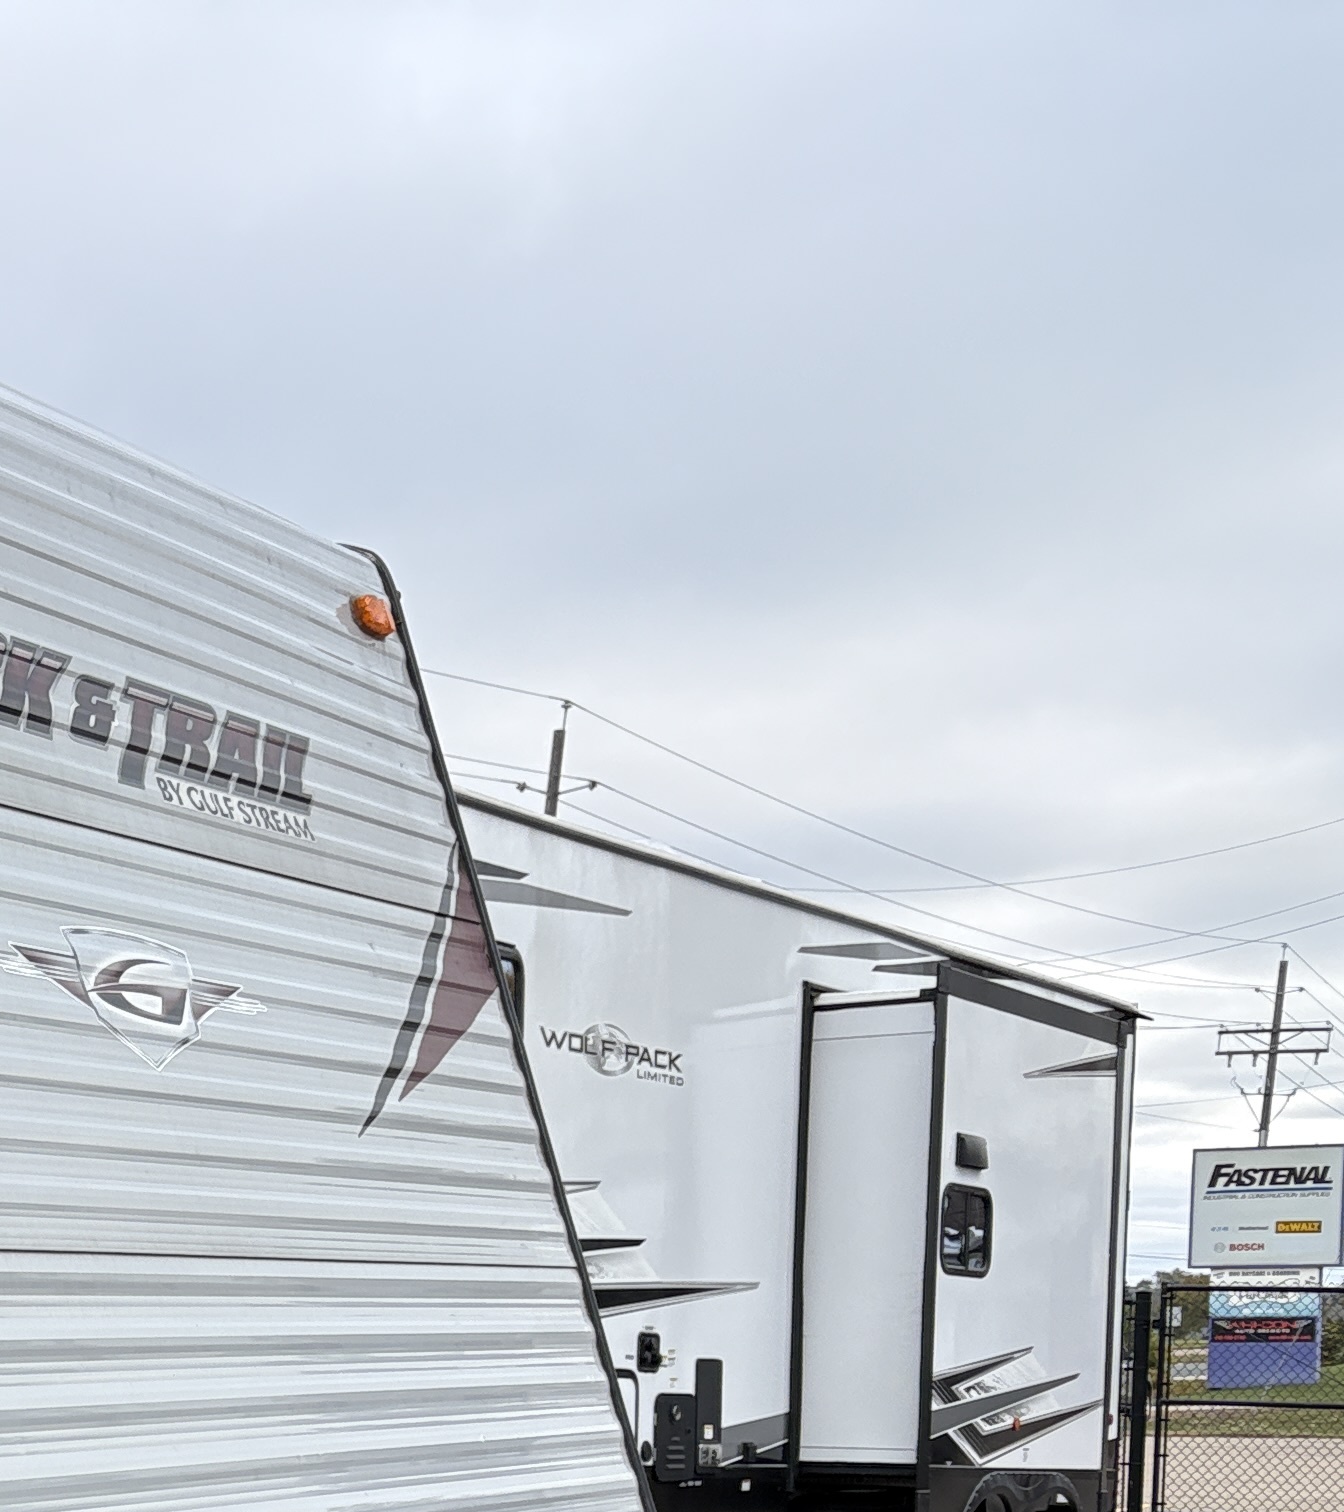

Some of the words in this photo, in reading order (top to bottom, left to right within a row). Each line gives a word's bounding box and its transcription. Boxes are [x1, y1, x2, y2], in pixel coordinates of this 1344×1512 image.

[67, 673, 118, 750] &
[117, 676, 312, 816] TRAIL
[156, 776, 184, 806] BY
[186, 786, 235, 820] GULF
[237, 800, 316, 842] STREAM
[539, 1026, 617, 1057] WOLF
[623, 1044, 684, 1073] PACK
[637, 1070, 684, 1086] LIMITED
[1208, 1163, 1332, 1187] FASTENAL
[1229, 1243, 1264, 1252] BOSCH
